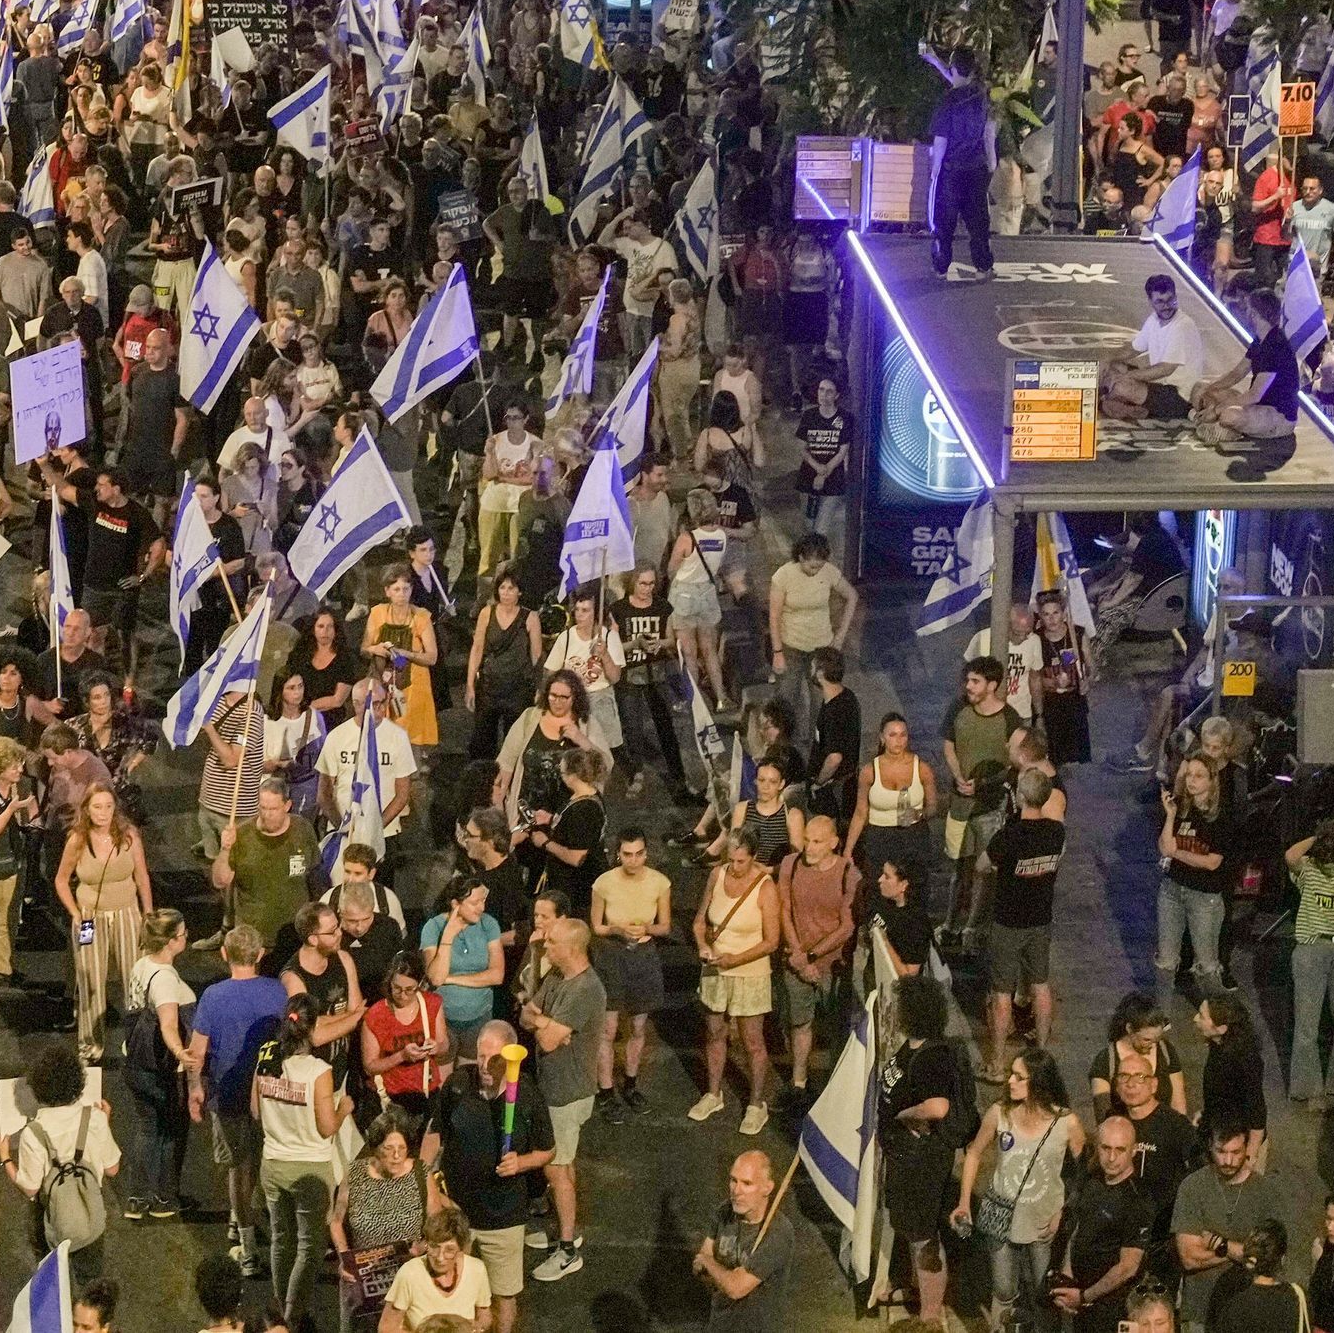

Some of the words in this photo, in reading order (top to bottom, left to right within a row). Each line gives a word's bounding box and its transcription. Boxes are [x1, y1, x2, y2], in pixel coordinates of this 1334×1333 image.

[207, 3, 220, 16] כי
[222, 3, 268, 17] אשתוק
[272, 1, 288, 15] לא
[210, 16, 252, 29] שינתה
[257, 18, 288, 30] ארצי
[268, 32, 288, 45] את
[1281, 85, 1314, 104] 7.10
[1229, 663, 1253, 677] 200
